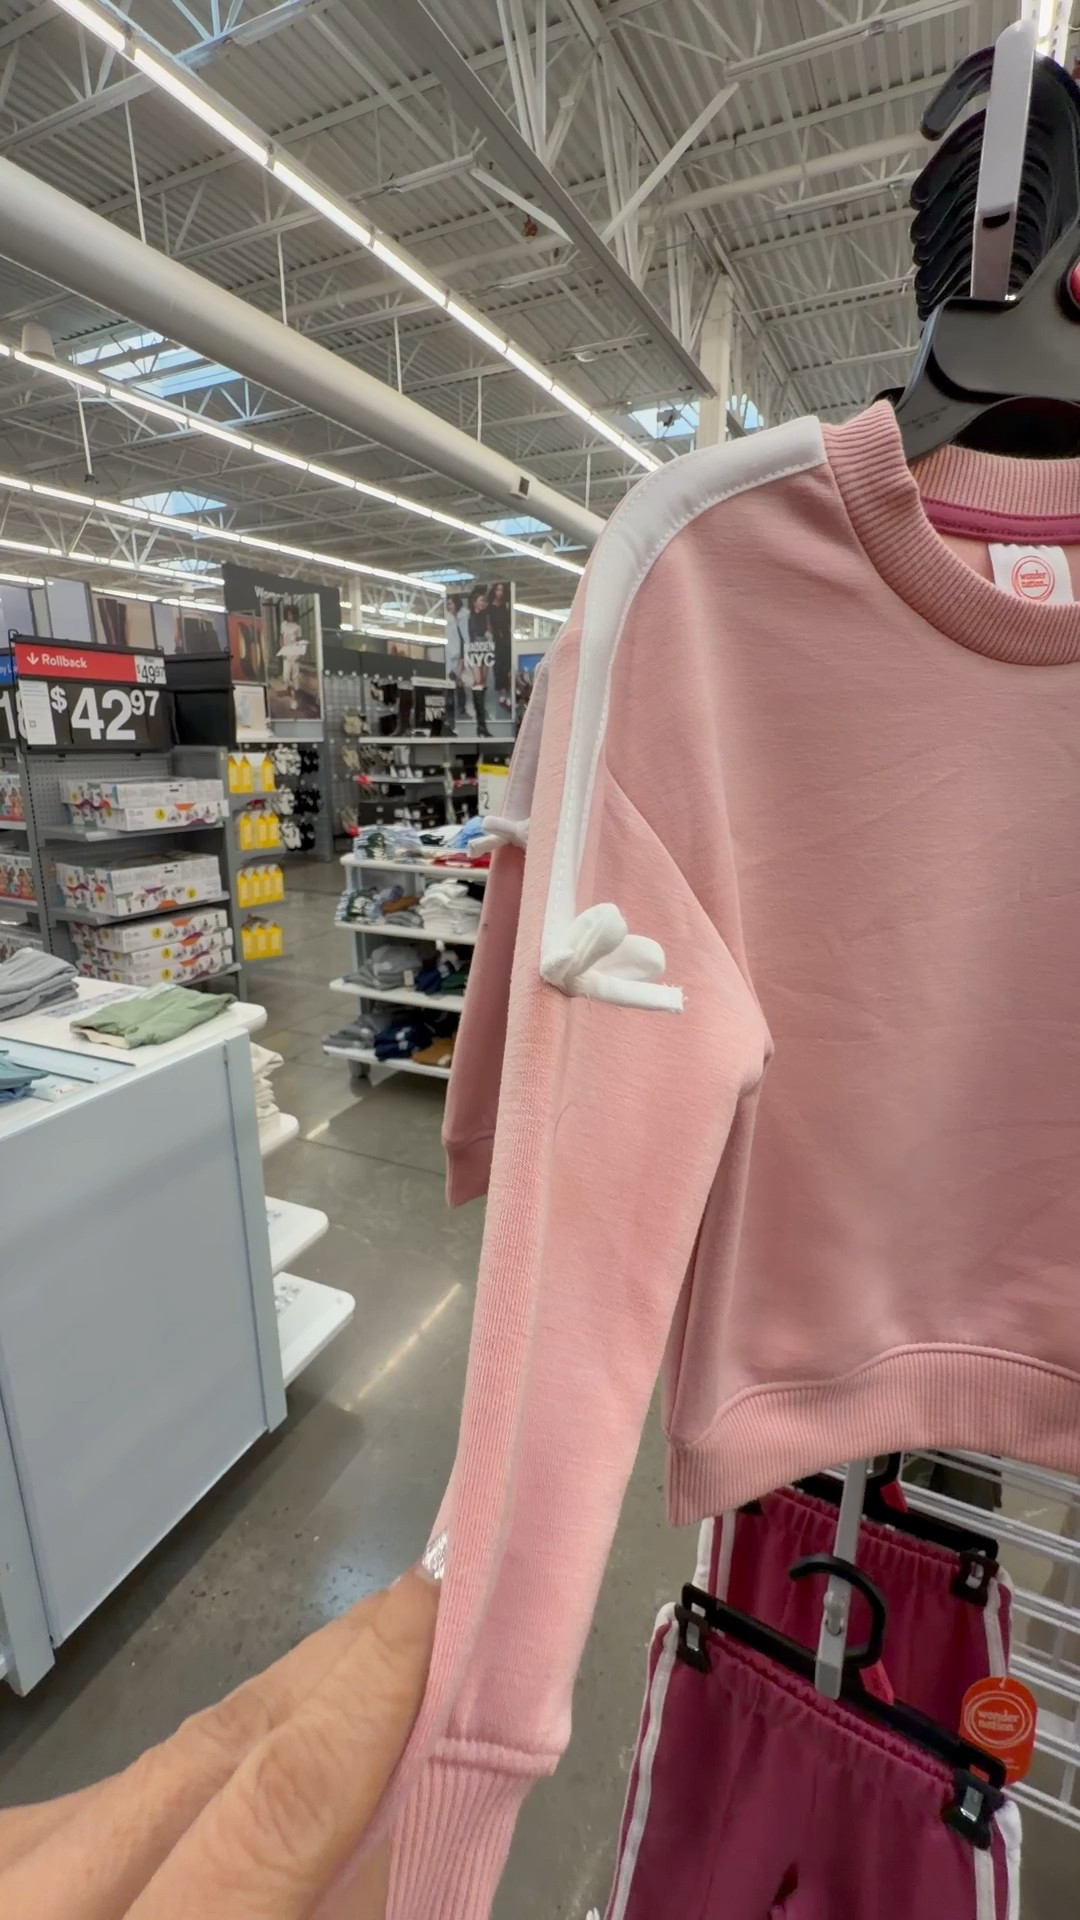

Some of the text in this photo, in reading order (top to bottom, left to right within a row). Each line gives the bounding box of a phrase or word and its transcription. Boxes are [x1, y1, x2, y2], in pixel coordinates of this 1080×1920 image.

[41, 653, 88, 669] Rollback
[463, 652, 497, 668] NYC
[977, 1709, 1020, 1723] wonder
